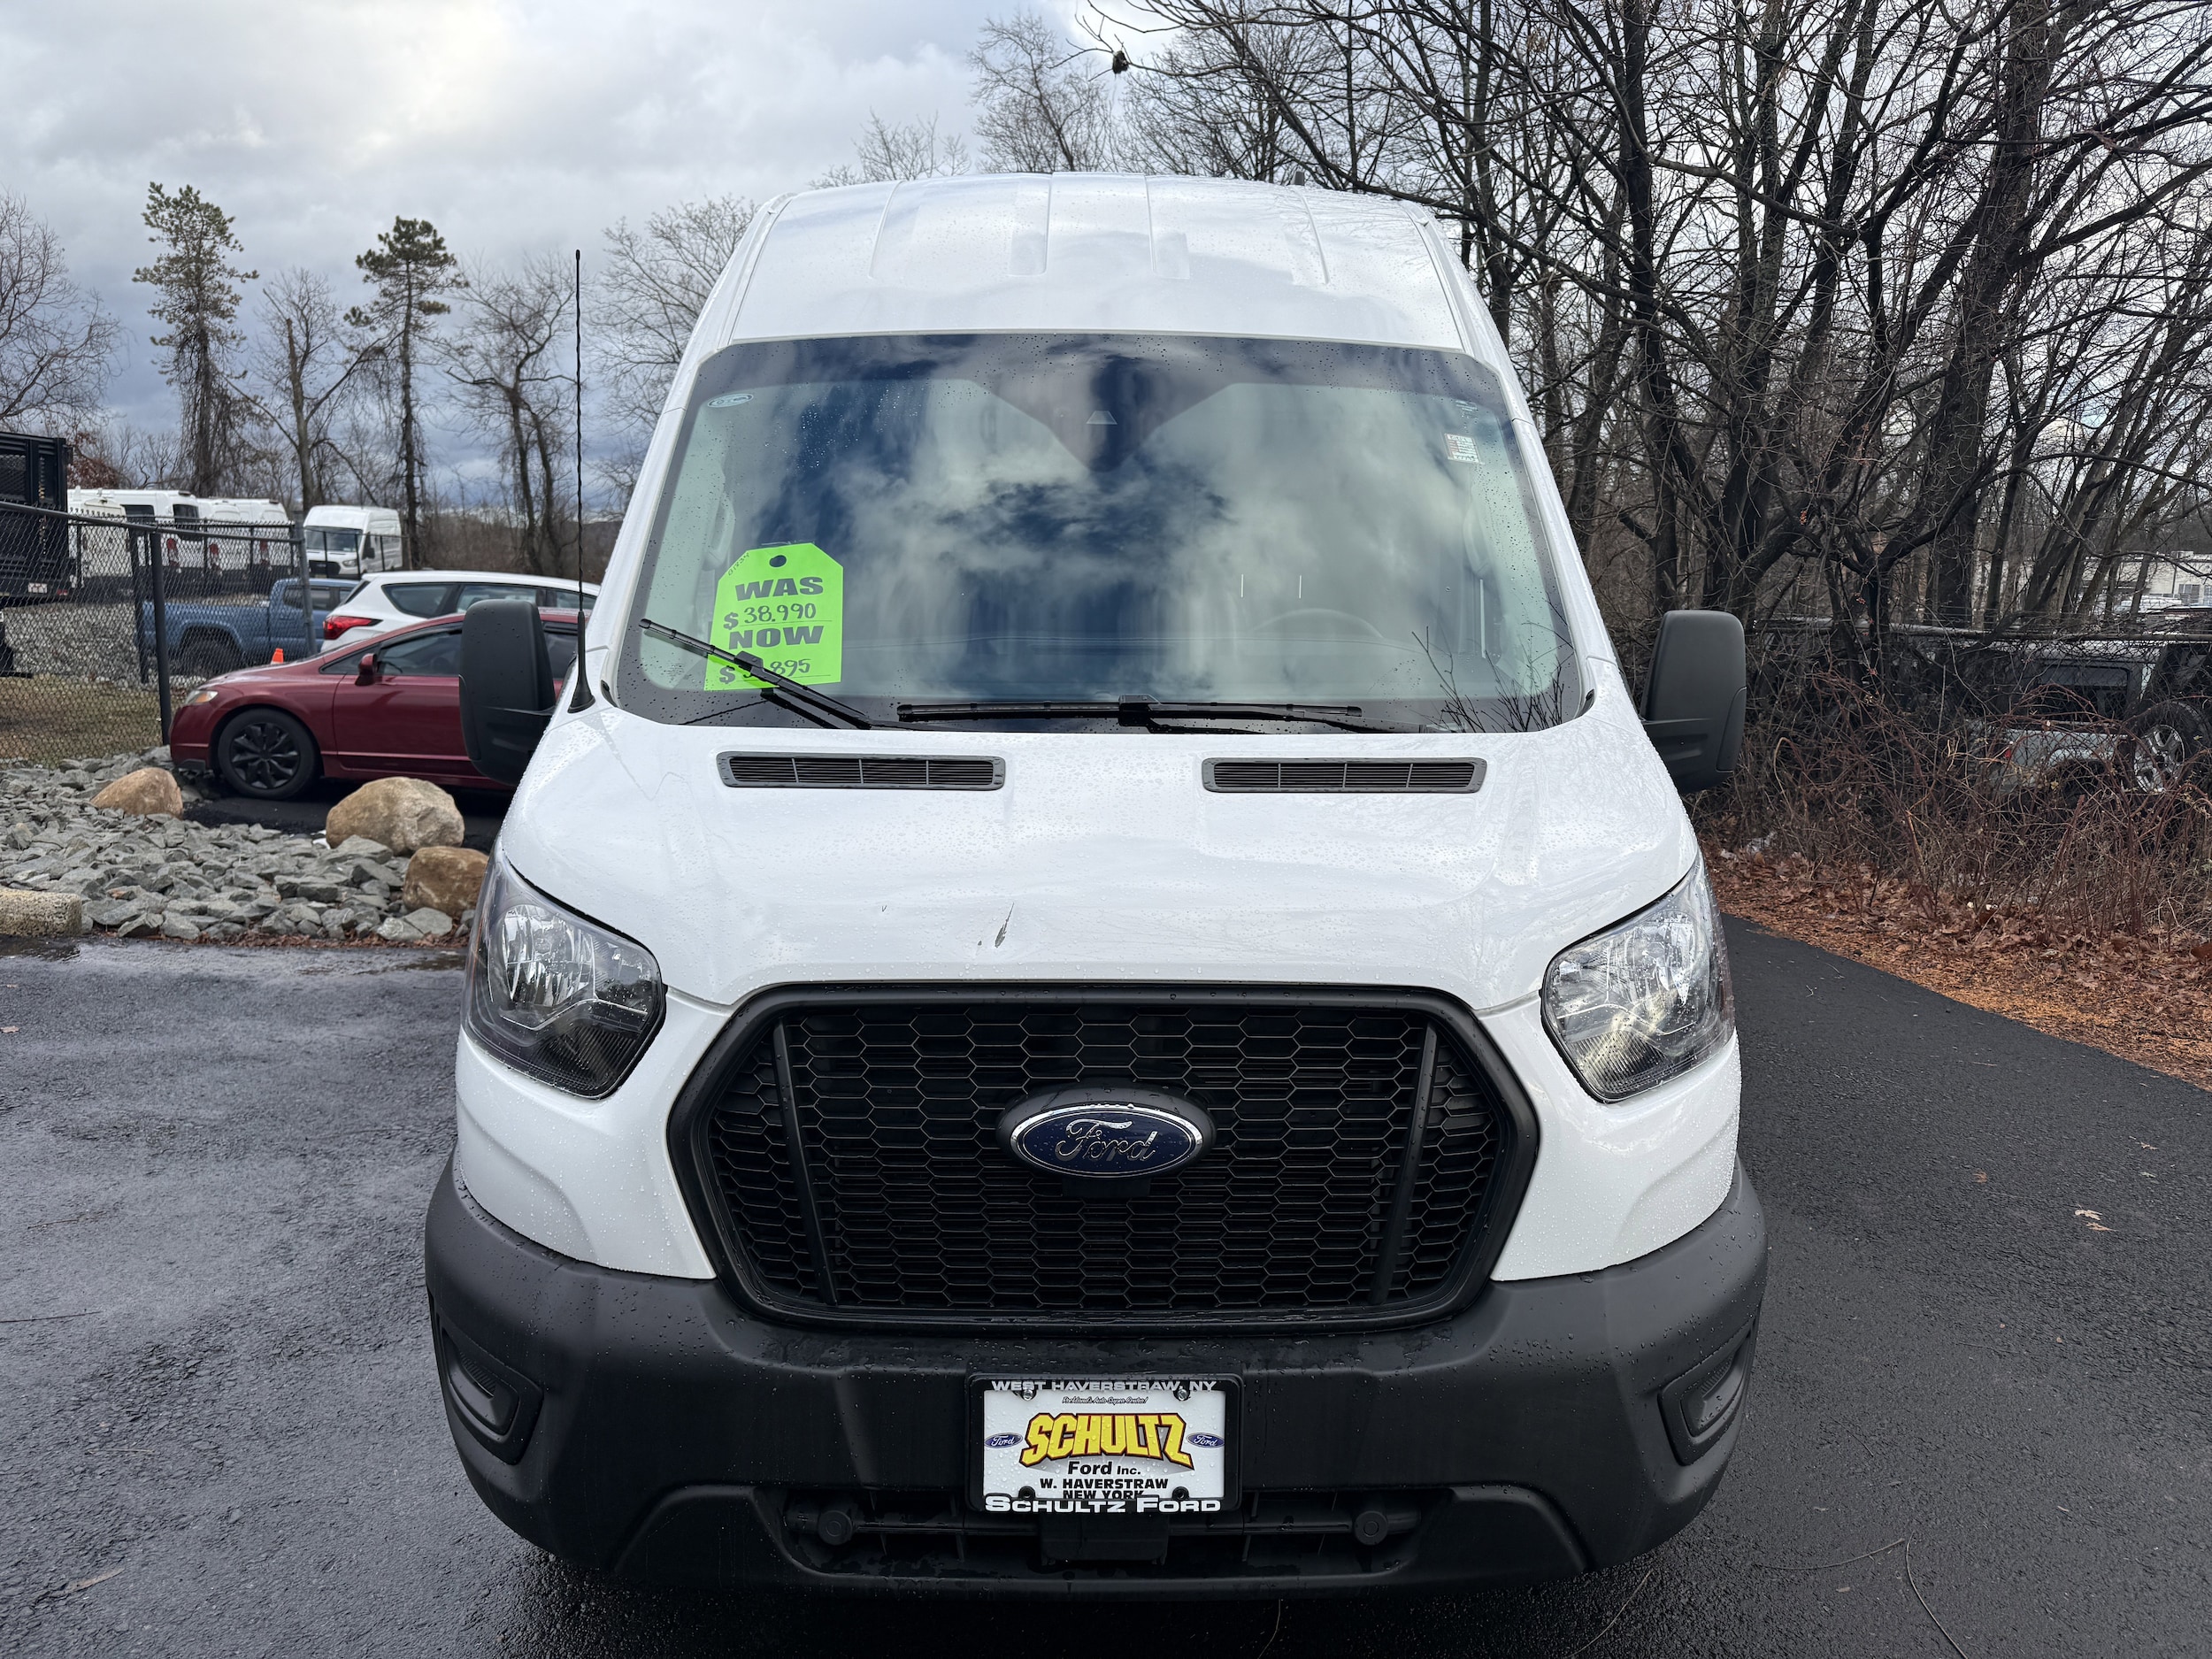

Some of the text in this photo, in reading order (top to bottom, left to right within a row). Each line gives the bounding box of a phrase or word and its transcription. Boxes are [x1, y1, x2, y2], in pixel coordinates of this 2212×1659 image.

[734, 577, 824, 601] WAS
[728, 626, 824, 649] NOW
[1055, 1118, 1158, 1162] Ford
[991, 1380, 1047, 1391] WEST
[1189, 1380, 1217, 1392] NY
[990, 1435, 1016, 1447] Ford
[1018, 1412, 1194, 1471] SCHULTZ
[1194, 1435, 1218, 1447] Ford
[1067, 1461, 1141, 1475] Ford Inc.
[1040, 1479, 1169, 1489] W. HAVERSTRAW
[1063, 1490, 1145, 1500] NEW YORK
